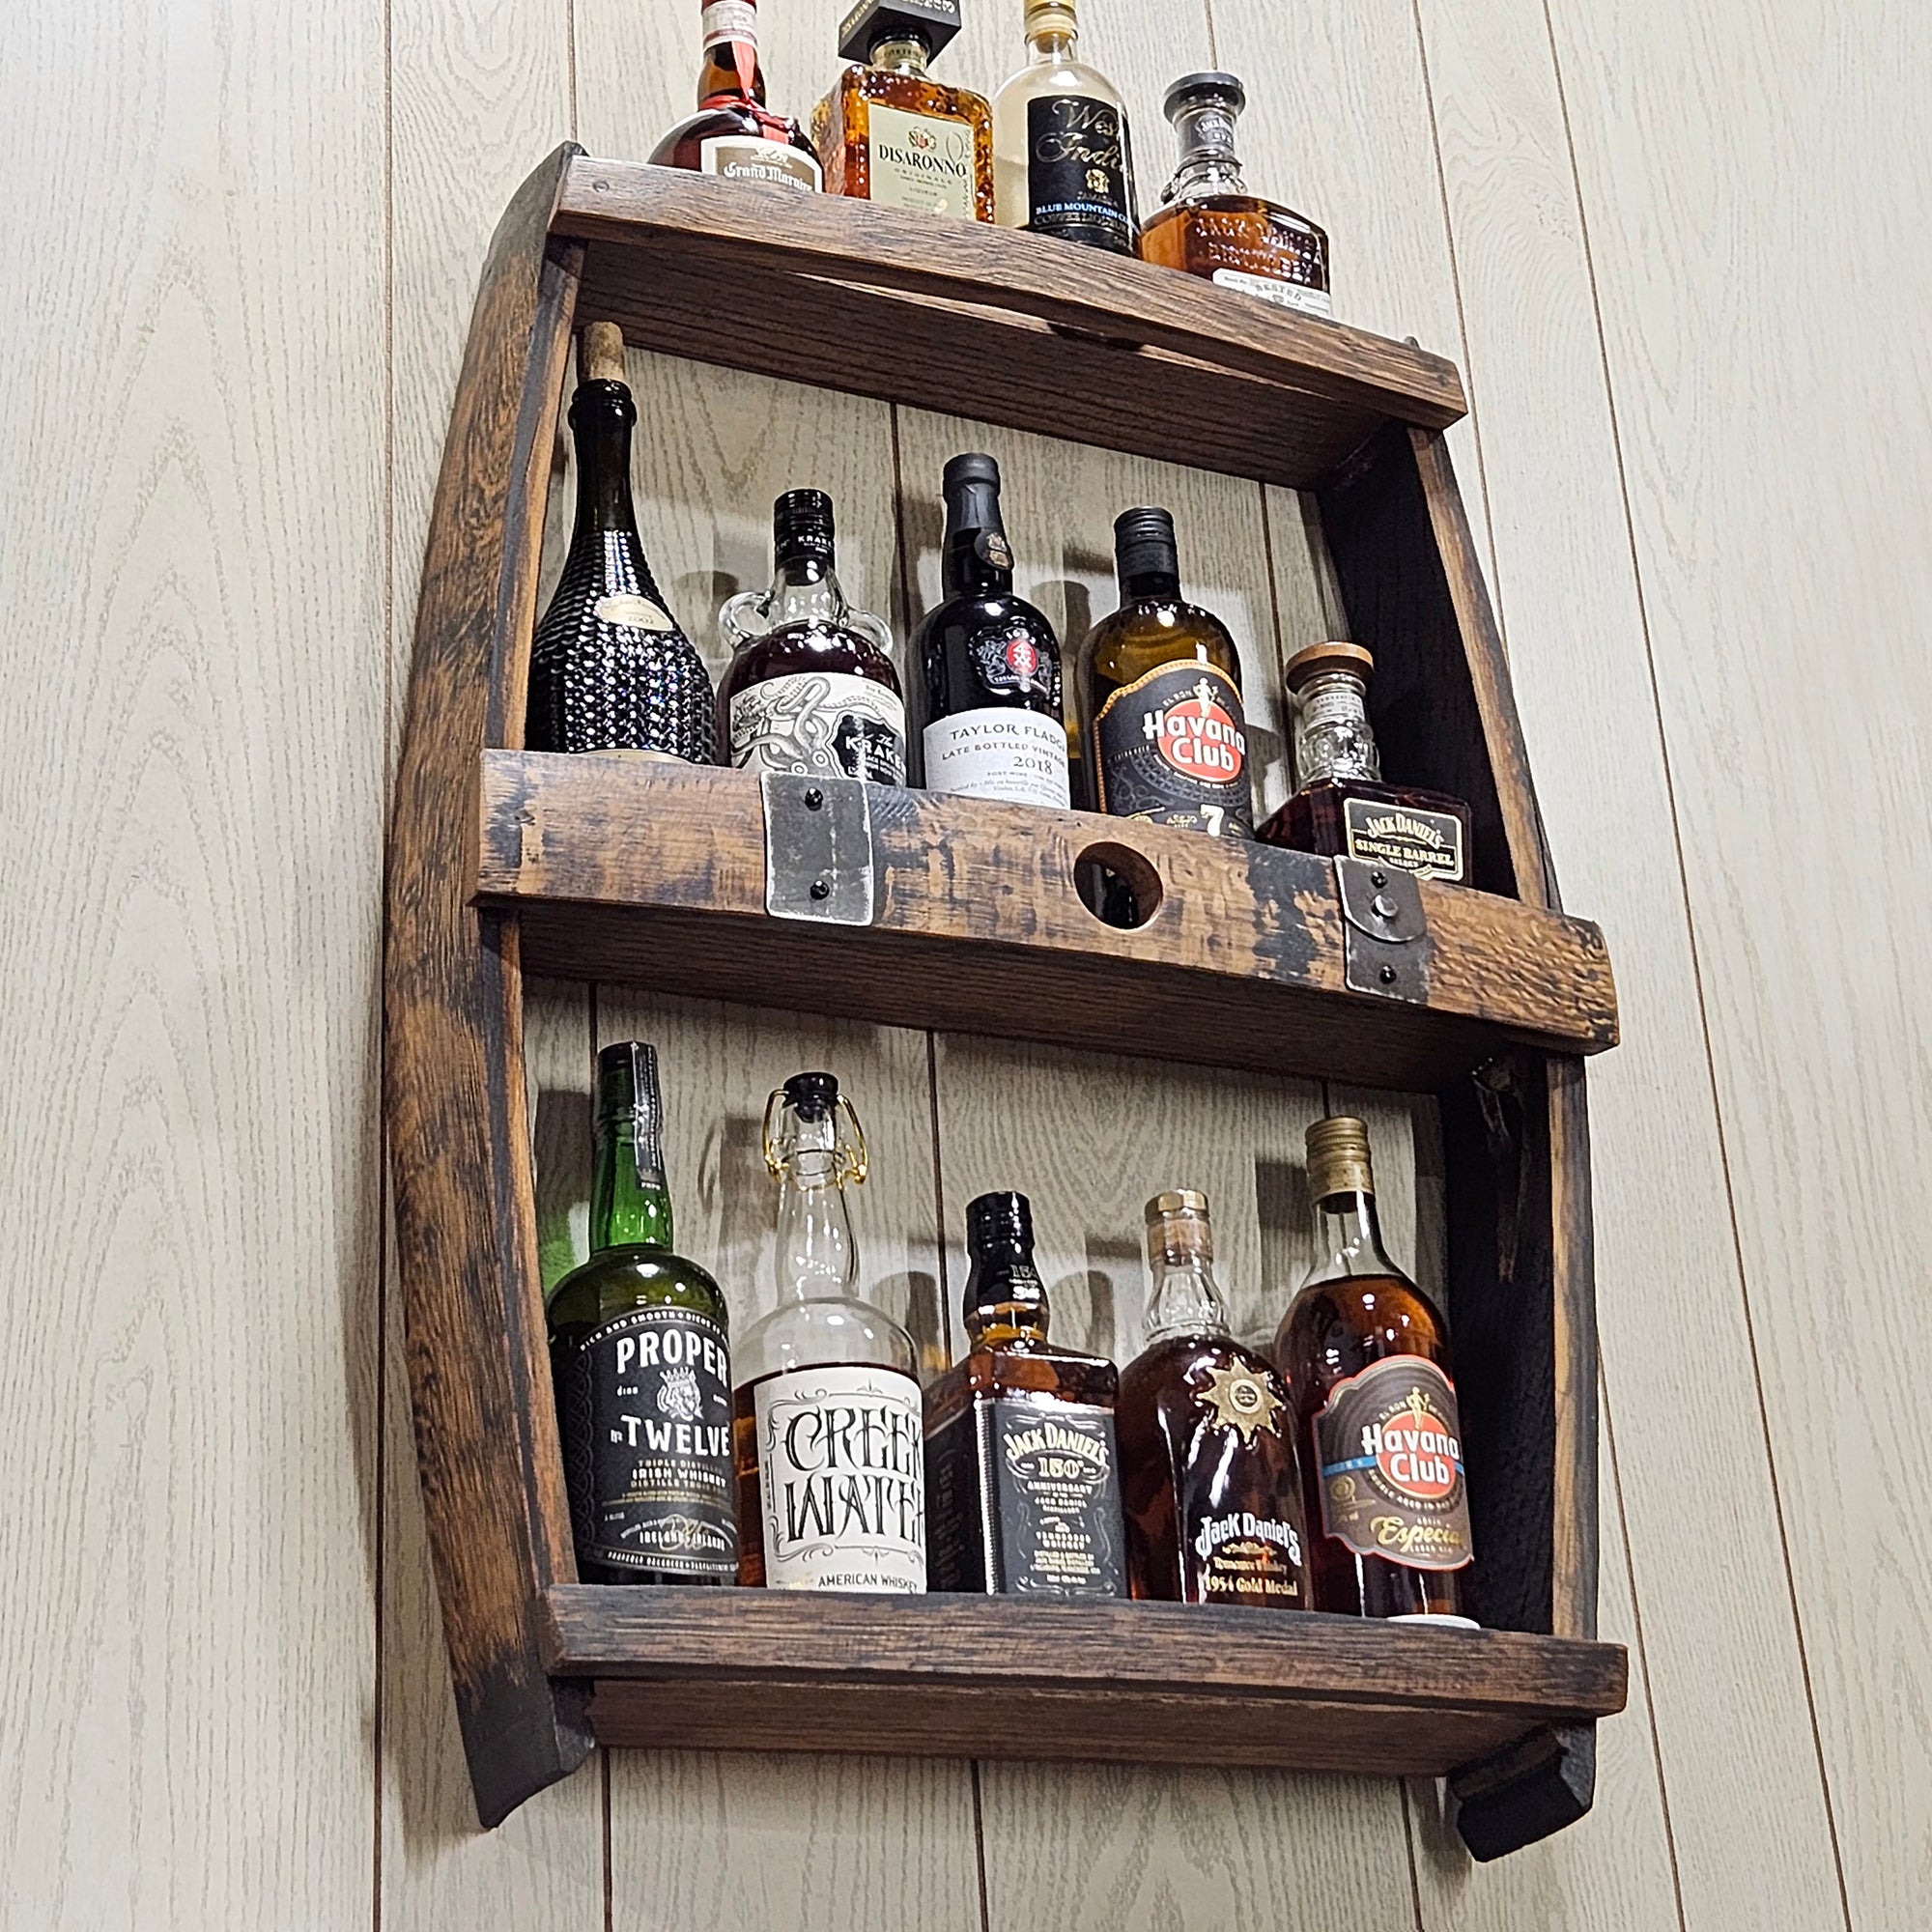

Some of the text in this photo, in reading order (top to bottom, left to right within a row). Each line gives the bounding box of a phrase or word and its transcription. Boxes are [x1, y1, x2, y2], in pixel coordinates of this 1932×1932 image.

[724, 161, 766, 178] Grand
[878, 144, 967, 178] DISARONNO
[1036, 203, 1063, 215] BLUE
[1064, 202, 1118, 218] MOUNTAIN
[950, 724, 1020, 741] TAYLOR
[1142, 709, 1246, 756] Havana
[942, 746, 970, 760] LATE
[975, 742, 1029, 752] BOTTLED
[1012, 755, 1053, 776] 2018
[1172, 737, 1236, 772] Club
[1200, 804, 1226, 838] 7
[1365, 812, 1445, 850] JACK DANIEL'S
[1354, 838, 1455, 867] SINGLE BARREL
[606, 1319, 628, 1334] AND
[630, 1310, 676, 1324] SMOOTH
[616, 1327, 727, 1387] PROPER
[620, 1414, 730, 1457] TWELVE
[1003, 1421, 1110, 1466] JACK DANIEL'S
[1361, 1423, 1460, 1461] Havana
[632, 1467, 726, 1489] IRISH WHISKEY
[1390, 1452, 1449, 1485] Club
[1027, 1480, 1093, 1495] ANNIVERSARY
[1397, 1494, 1422, 1510] AGED
[1195, 1512, 1302, 1567] Jack Daniel's
[1369, 1516, 1463, 1553] Especia
[817, 1573, 918, 1595] AMERICAN WHISKEY
[1206, 1575, 1299, 1597] 1954 Gold Medal
